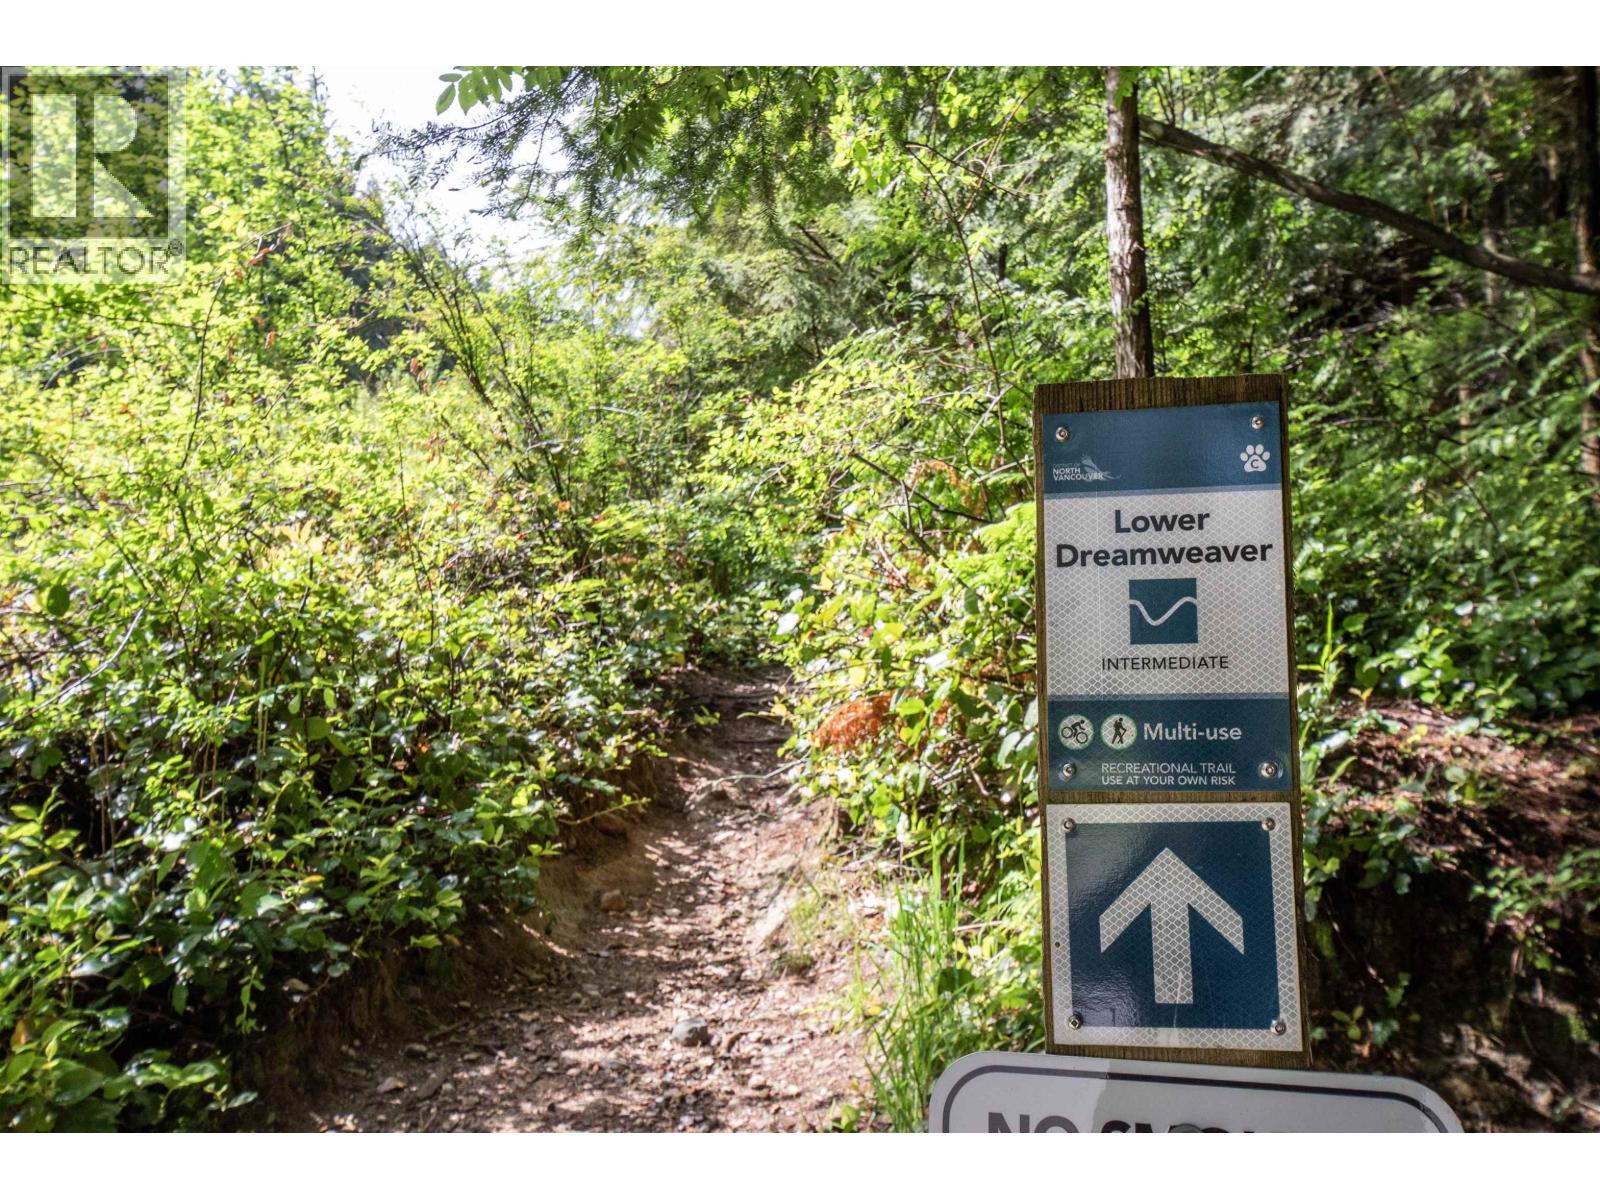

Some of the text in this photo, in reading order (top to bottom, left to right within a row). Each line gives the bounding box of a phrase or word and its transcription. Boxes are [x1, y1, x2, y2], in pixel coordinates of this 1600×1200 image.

[1053, 467, 1081, 475] NORTH
[1115, 509, 1210, 533] Lower
[1056, 543, 1273, 568] Dreamweaver
[1102, 656, 1229, 671] INTERMEDIATE
[1143, 722, 1242, 741] Multi-use
[1101, 762, 1237, 774] RECREATIONAL TRAIL
[1101, 776, 1236, 785] USE AT YOUR OWN RISK
